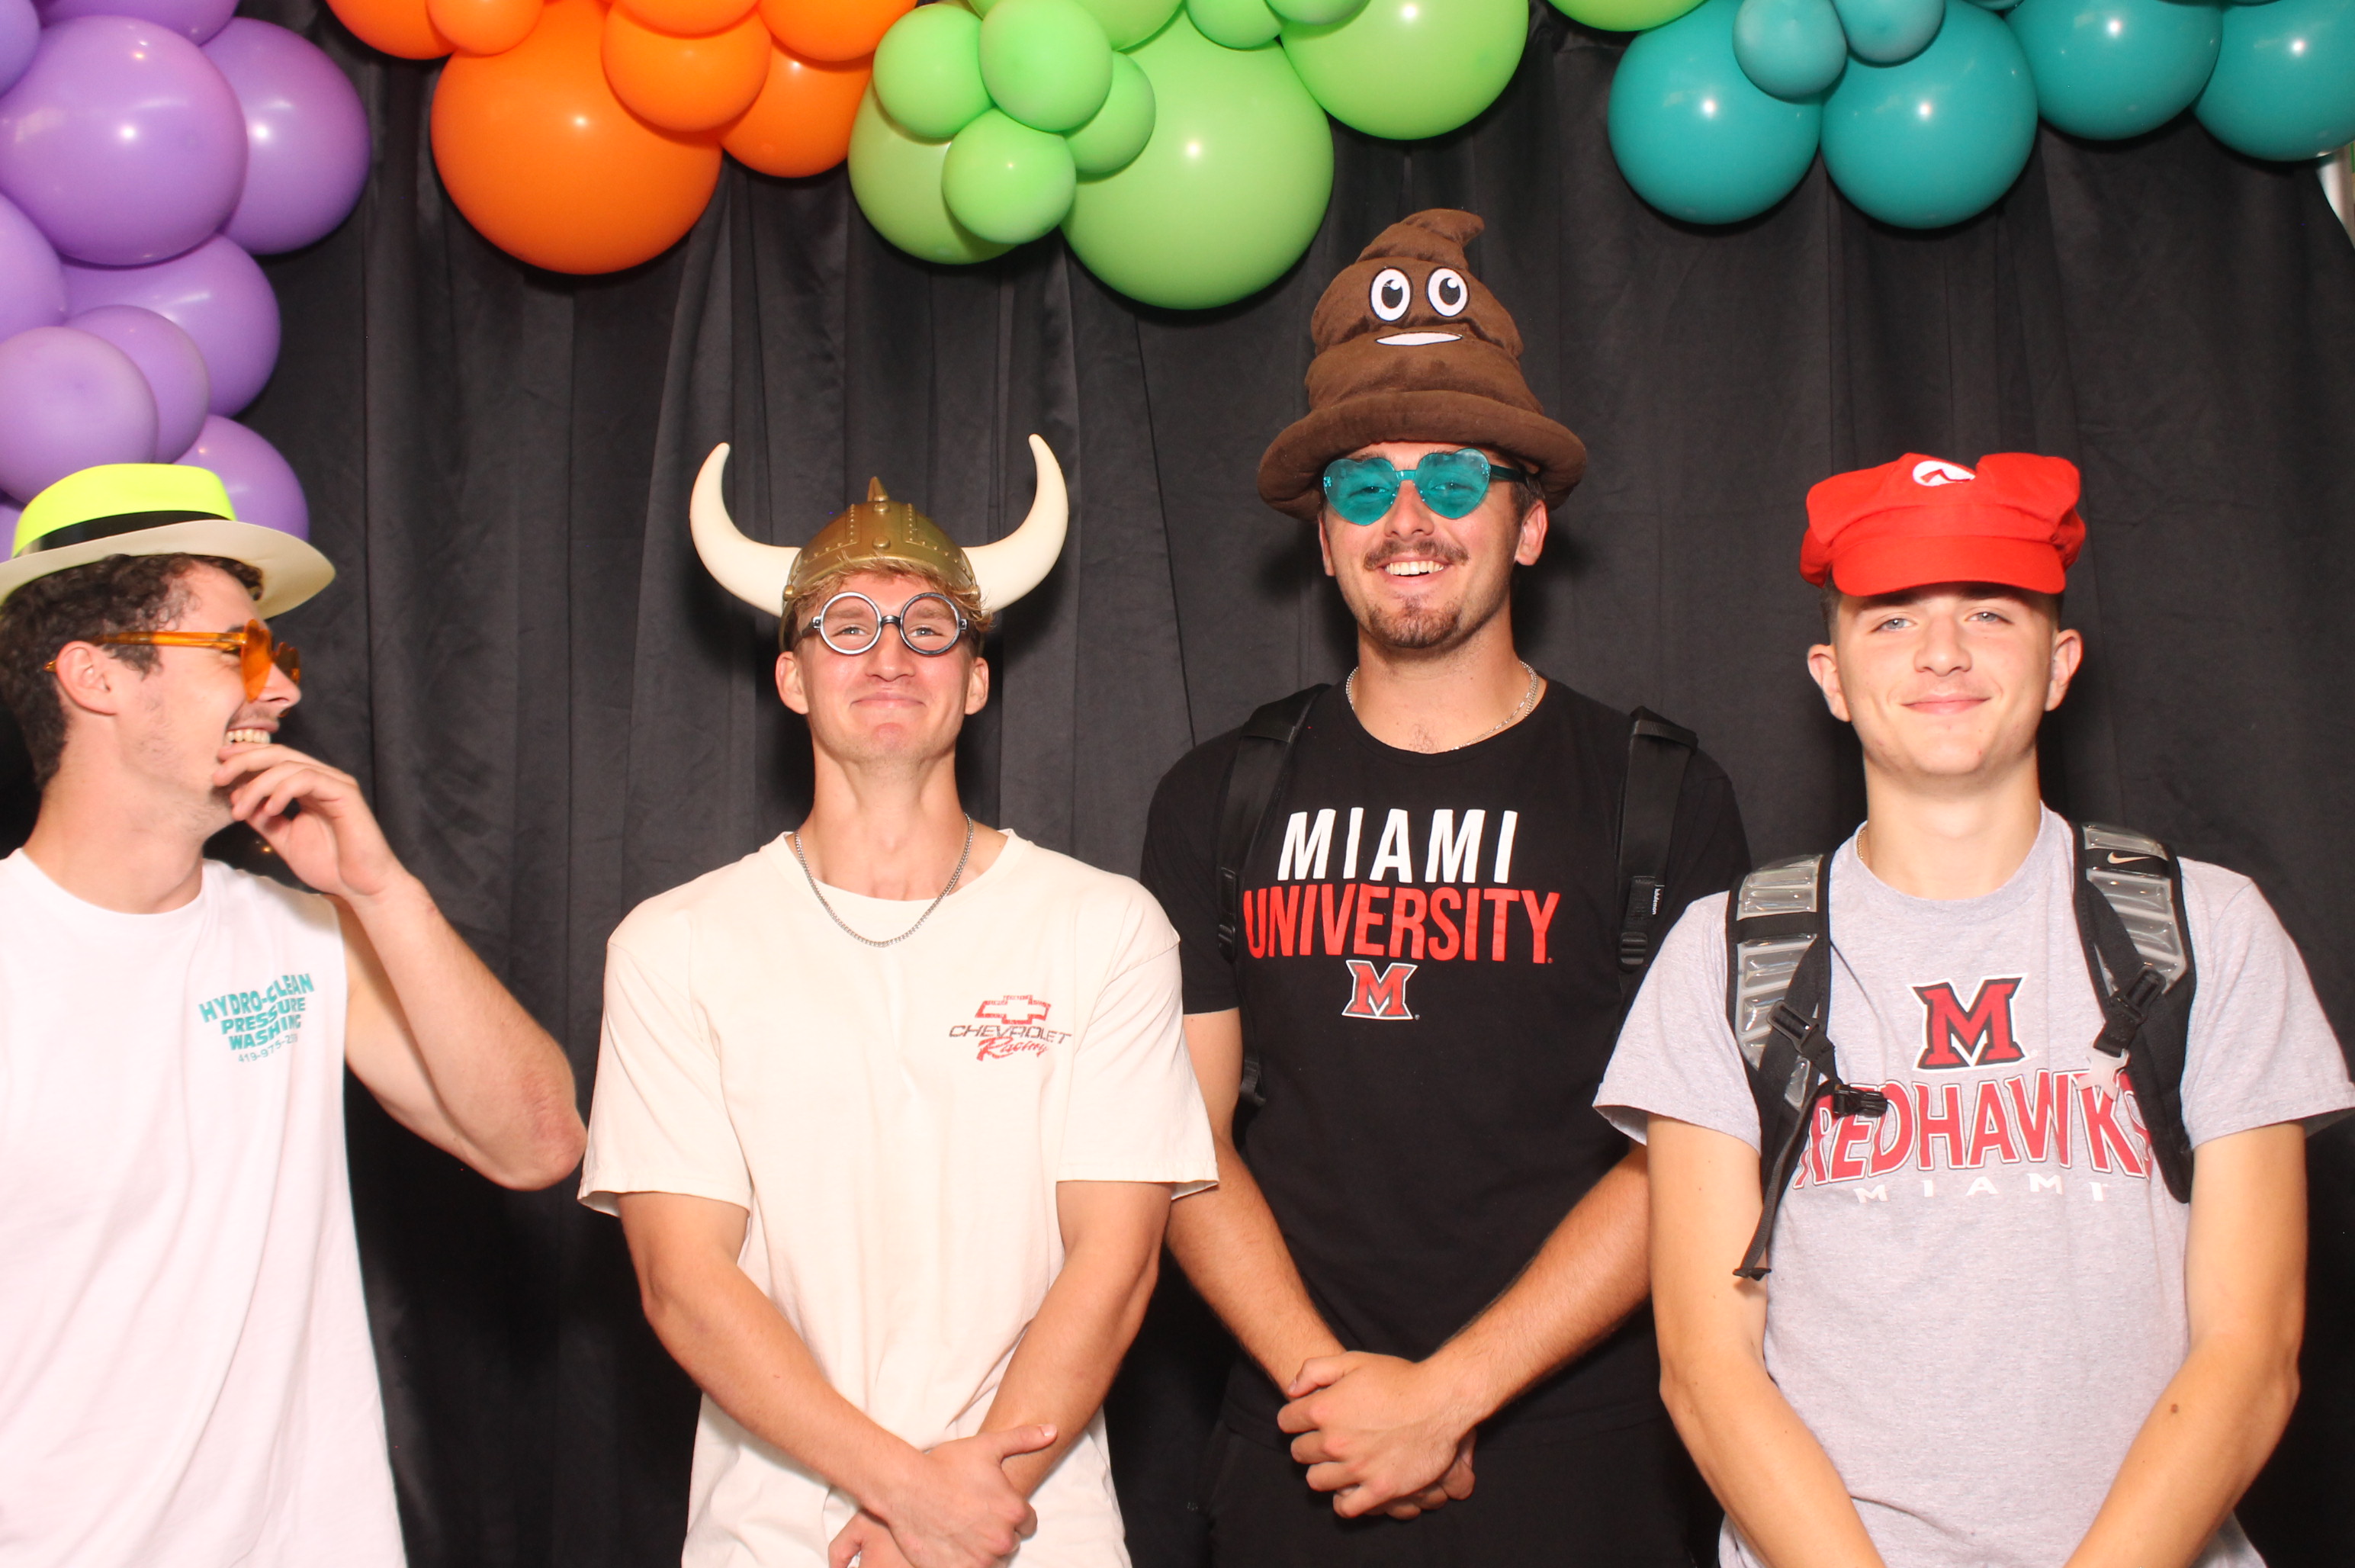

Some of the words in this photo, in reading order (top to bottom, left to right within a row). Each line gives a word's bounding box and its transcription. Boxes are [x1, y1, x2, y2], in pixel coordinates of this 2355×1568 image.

[1277, 807, 1518, 883] MIAMI
[1243, 883, 1560, 964] UNIVERSITY
[198, 973, 315, 1023] HYDRO-CLEAN
[1341, 959, 1418, 1020] M
[220, 997, 307, 1035] PRESSURE
[949, 1024, 1072, 1044] CHEVROLET
[1908, 972, 2031, 1073] M
[976, 1036, 1049, 1062] Racing
[1853, 1173, 2106, 1203] MIAMI
